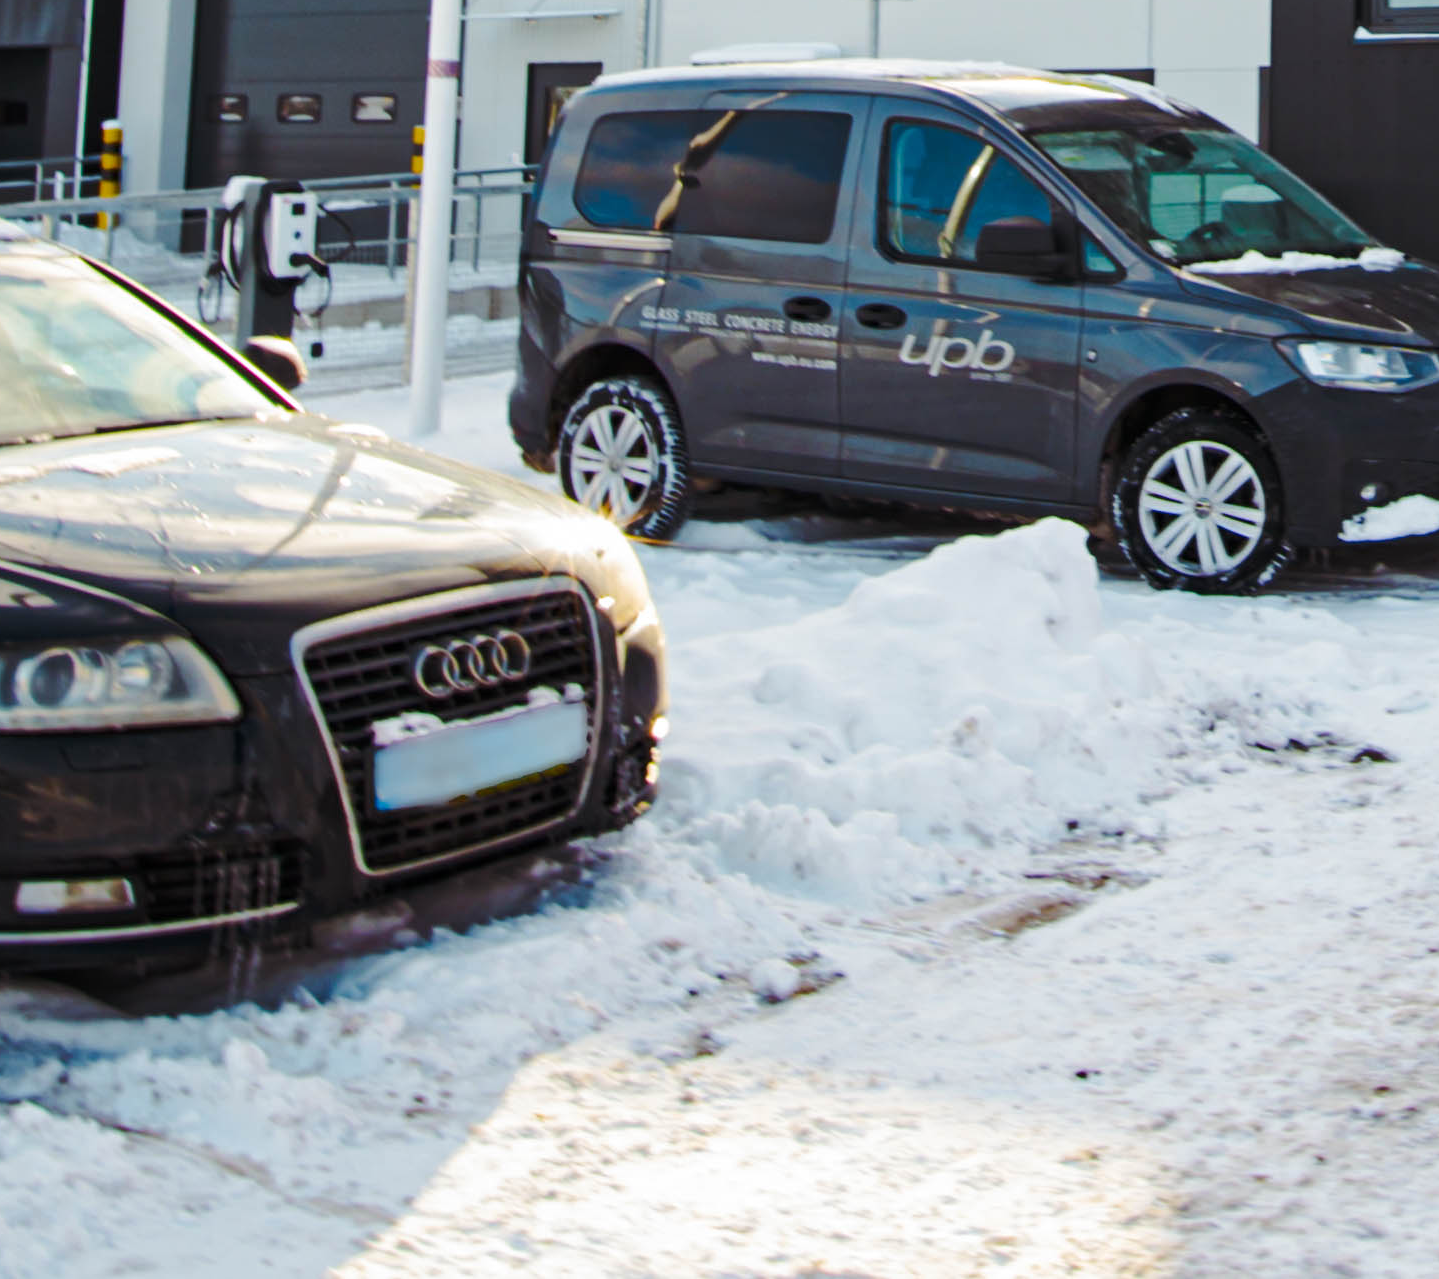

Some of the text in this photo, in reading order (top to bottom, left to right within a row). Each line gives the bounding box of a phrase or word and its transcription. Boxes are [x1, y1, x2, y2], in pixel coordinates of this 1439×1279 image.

[640, 305, 680, 322] GLASS
[684, 309, 719, 327] STEEL
[724, 314, 786, 333] CONCRETE
[790, 321, 839, 338] ENERGY
[899, 329, 1016, 377] upb
